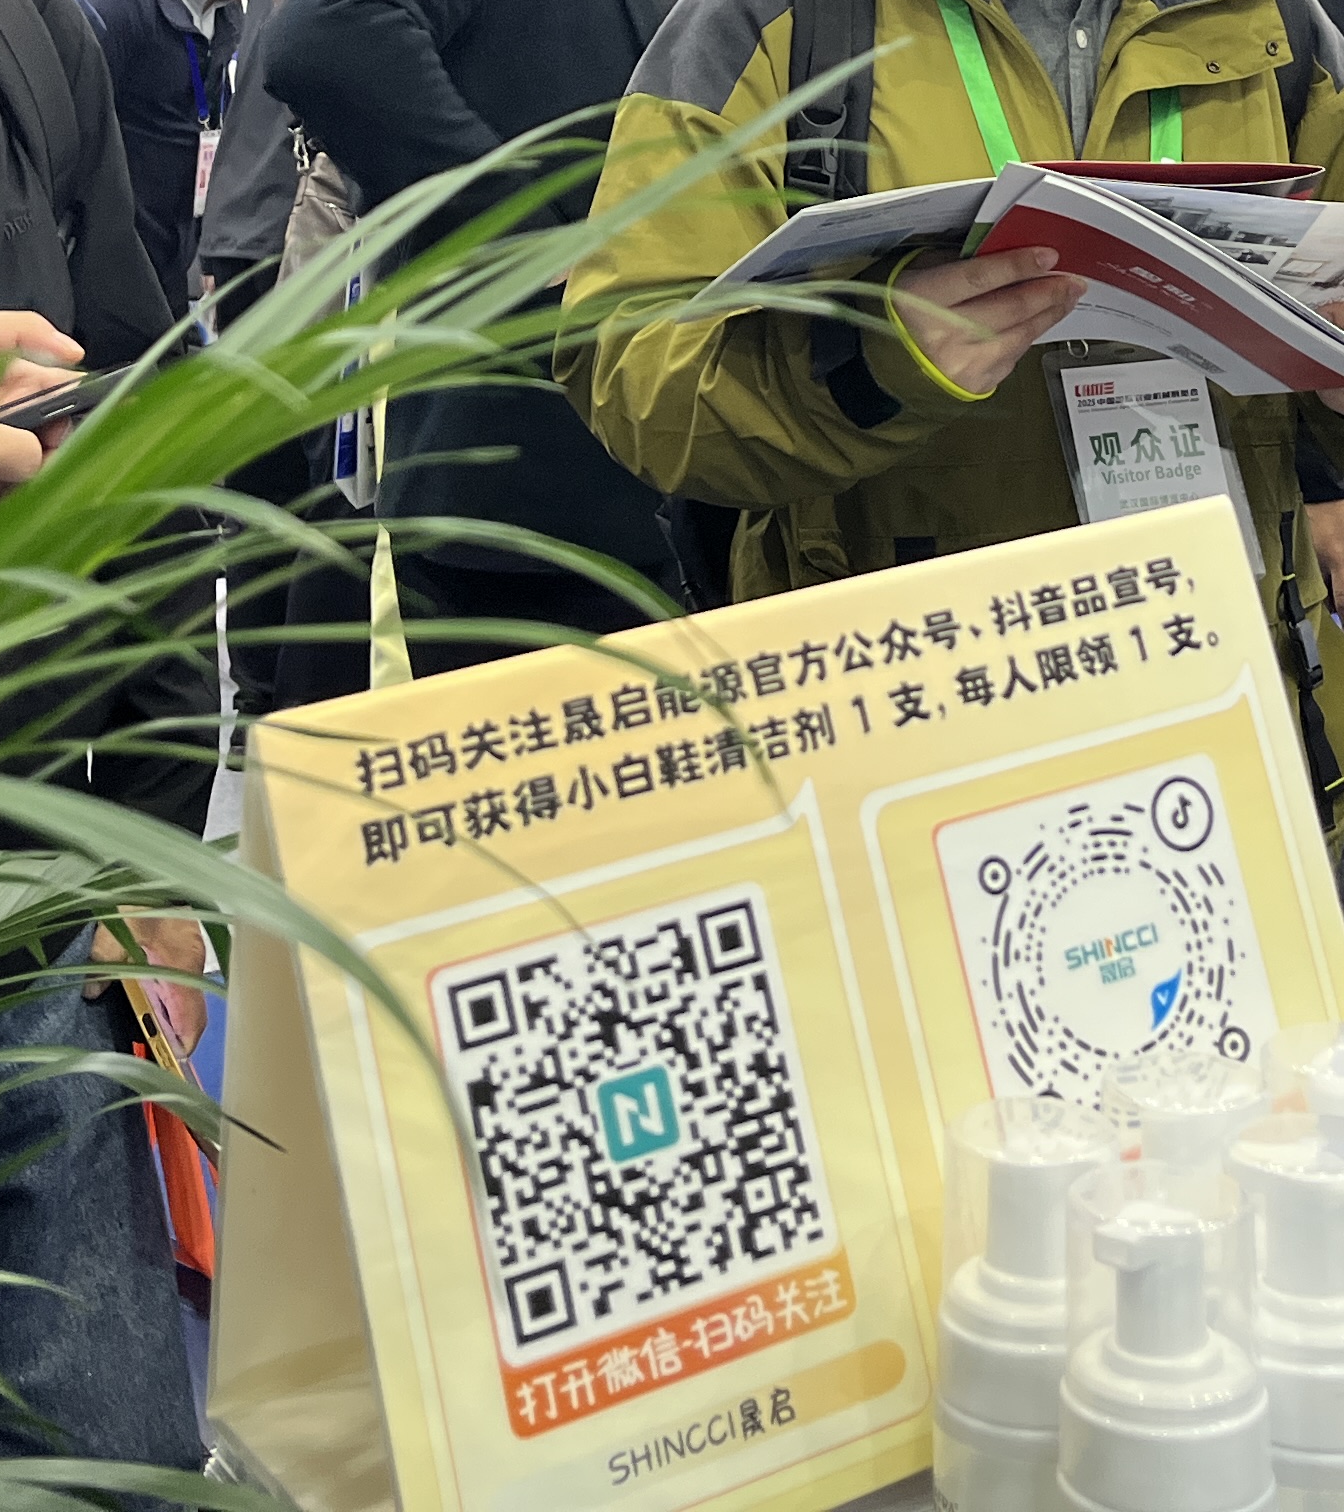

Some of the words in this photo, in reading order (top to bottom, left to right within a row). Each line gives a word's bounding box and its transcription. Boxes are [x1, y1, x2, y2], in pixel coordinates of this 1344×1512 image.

[1089, 423, 1206, 465] 观众证
[1101, 470, 1151, 485] Visitor
[1155, 463, 1202, 480] Badge
[1064, 922, 1158, 970] SHINCCI
